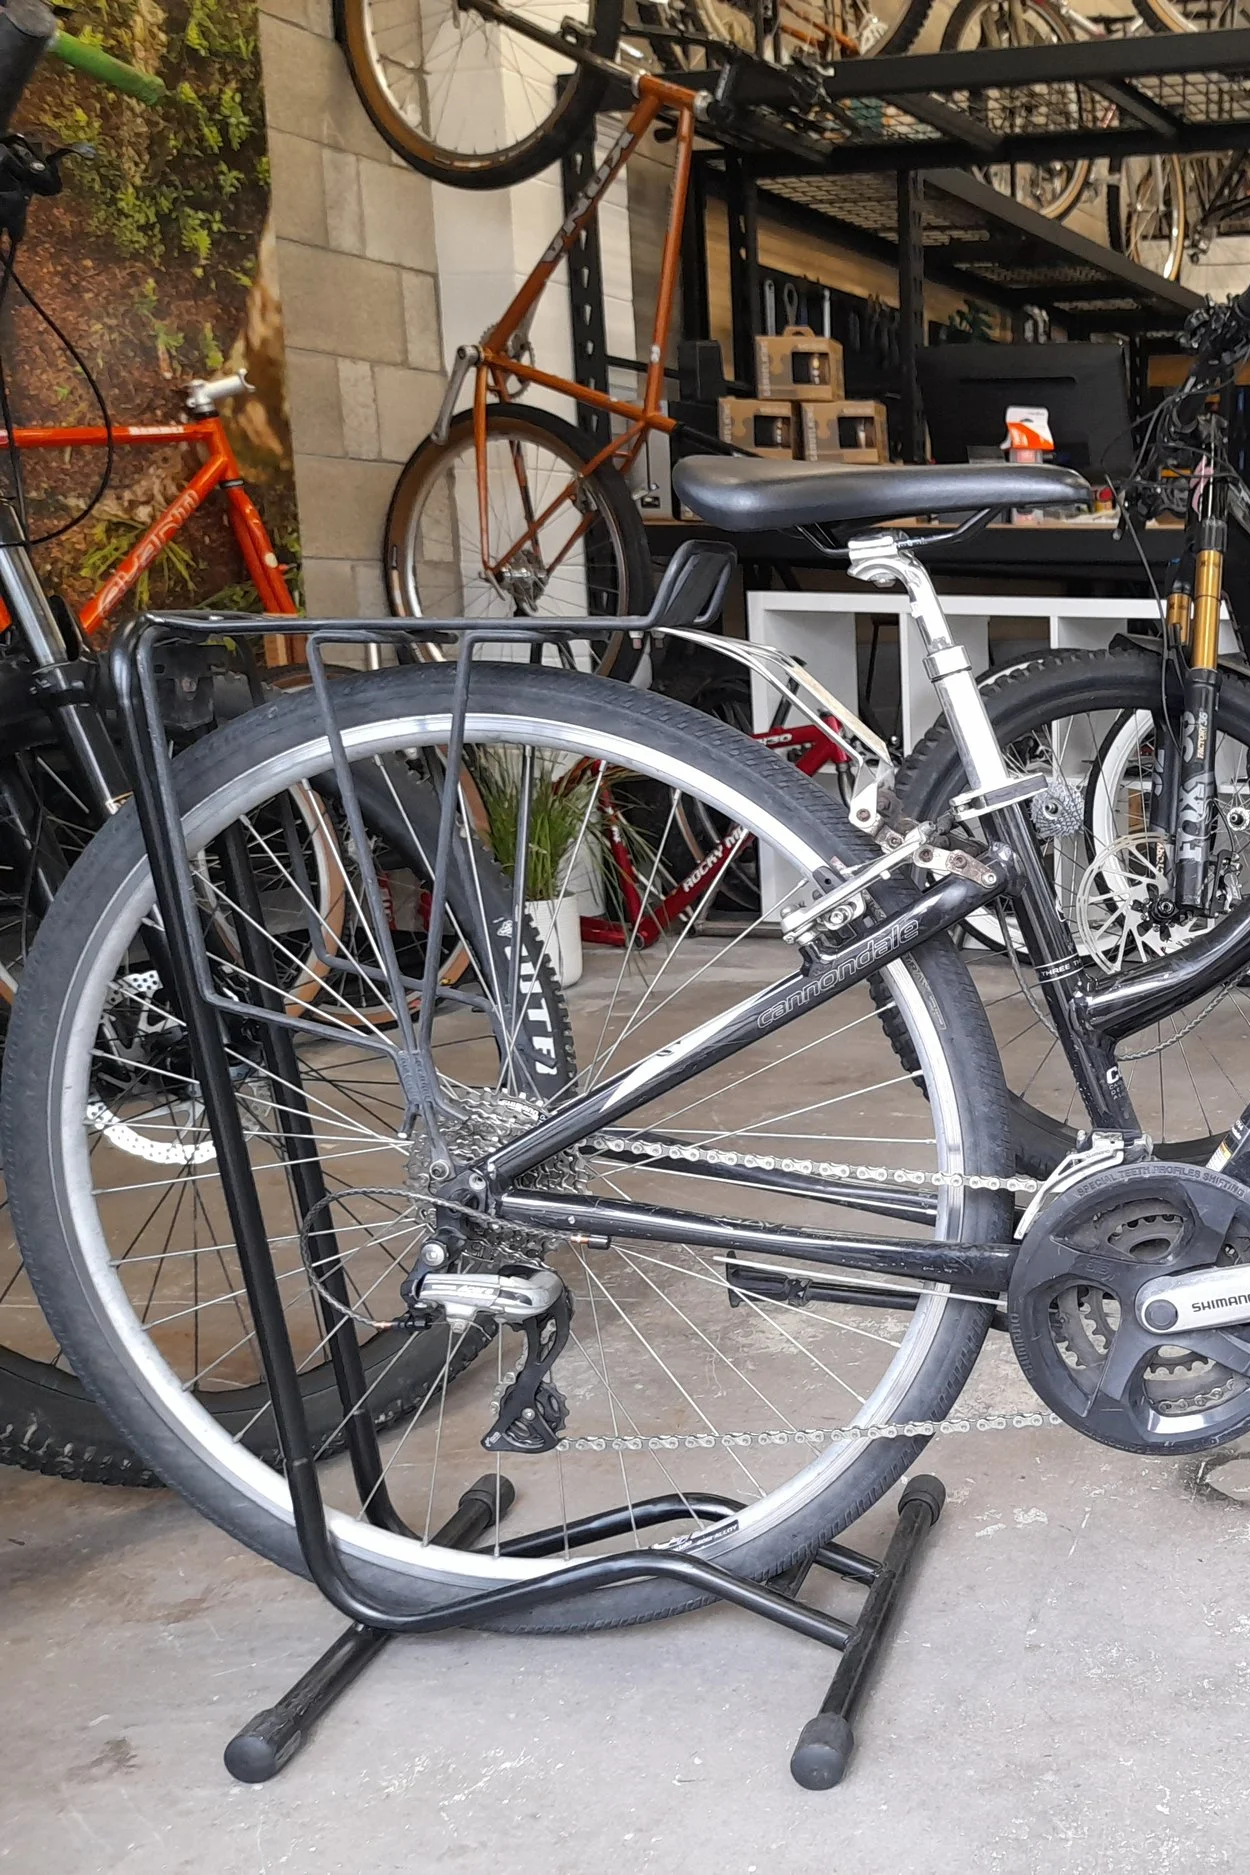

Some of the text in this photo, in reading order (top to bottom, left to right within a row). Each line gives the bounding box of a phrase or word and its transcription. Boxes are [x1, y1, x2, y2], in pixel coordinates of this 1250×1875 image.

[681, 842, 725, 892] ROCKY
[756, 915, 919, 1029] cannondale
[1040, 963, 1072, 978] THREE
[1076, 1164, 1245, 1198] SPECIAL TEETH PROFILES SHIFTING
